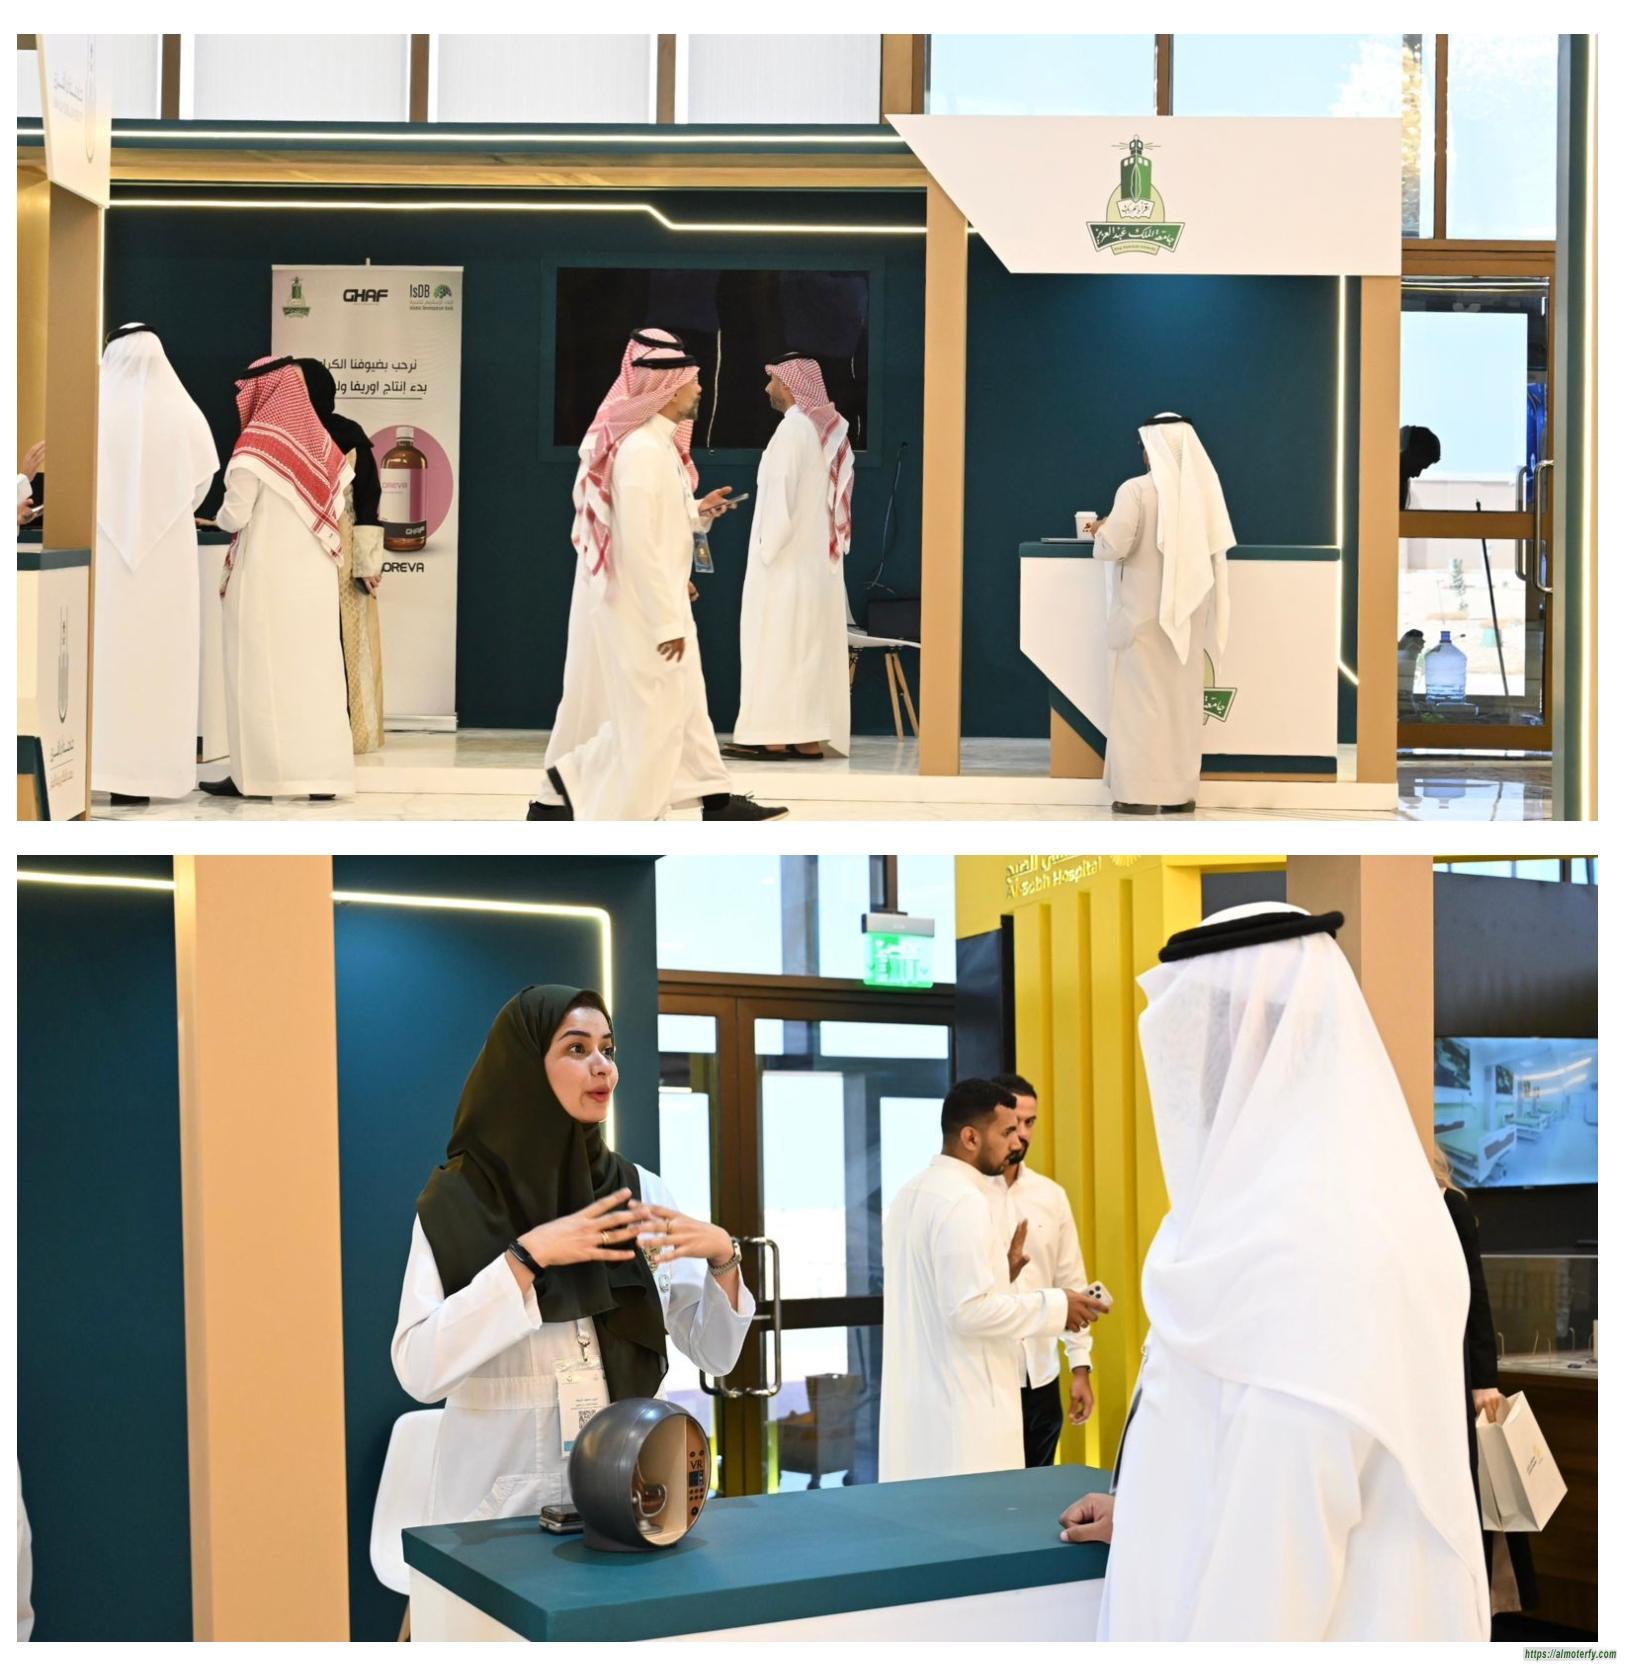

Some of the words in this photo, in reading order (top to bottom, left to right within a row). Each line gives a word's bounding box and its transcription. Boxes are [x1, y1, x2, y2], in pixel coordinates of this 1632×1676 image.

[343, 288, 389, 303] GHAF
[409, 283, 431, 299] IsDB
[350, 359, 388, 373] بضيوفنا
[391, 359, 417, 374] نرحب
[382, 381, 407, 395] إنتاج
[410, 382, 428, 395] بدء
[1052, 855, 1103, 887] Hospital
